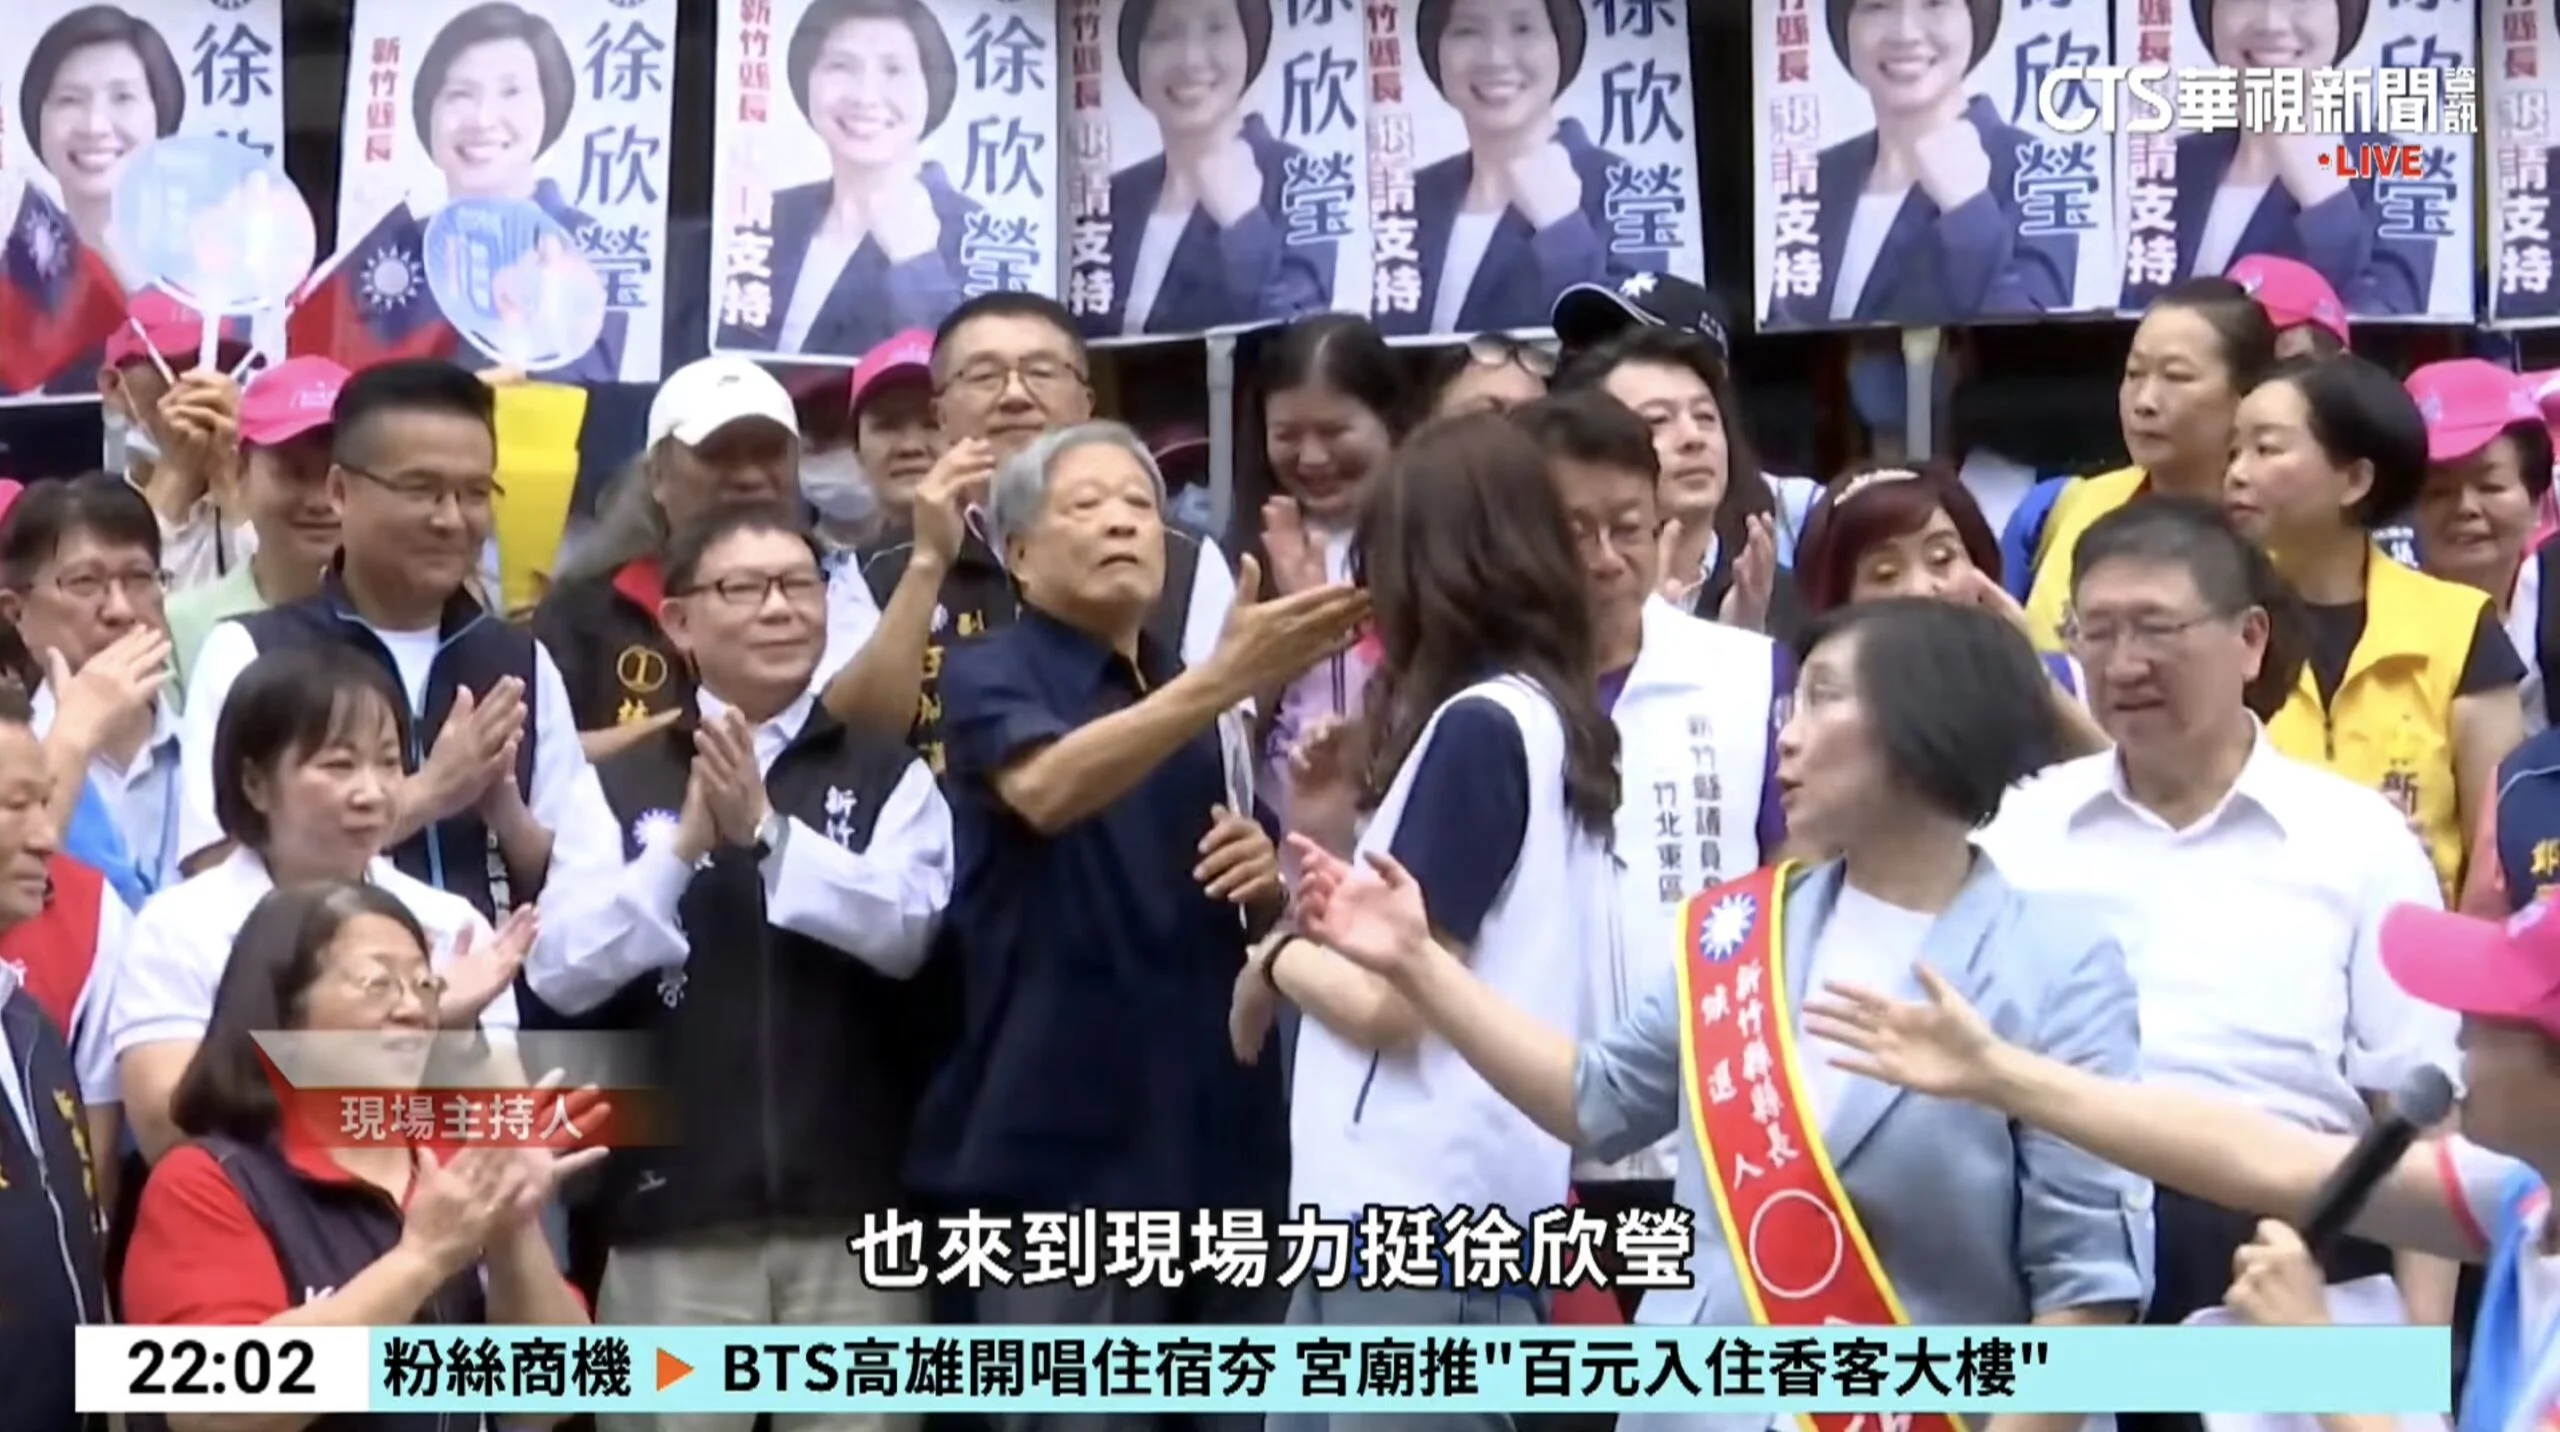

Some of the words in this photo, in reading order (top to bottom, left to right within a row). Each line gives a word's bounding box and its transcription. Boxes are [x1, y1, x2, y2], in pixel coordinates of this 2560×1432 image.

[363, 36, 402, 163] 新竹縣長
[960, 12, 1047, 296] 徐欣瑩
[2010, 0, 2101, 236] 欣瑩
[2502, 0, 2538, 79] 縣長
[574, 20, 666, 309] 徐欣瑩
